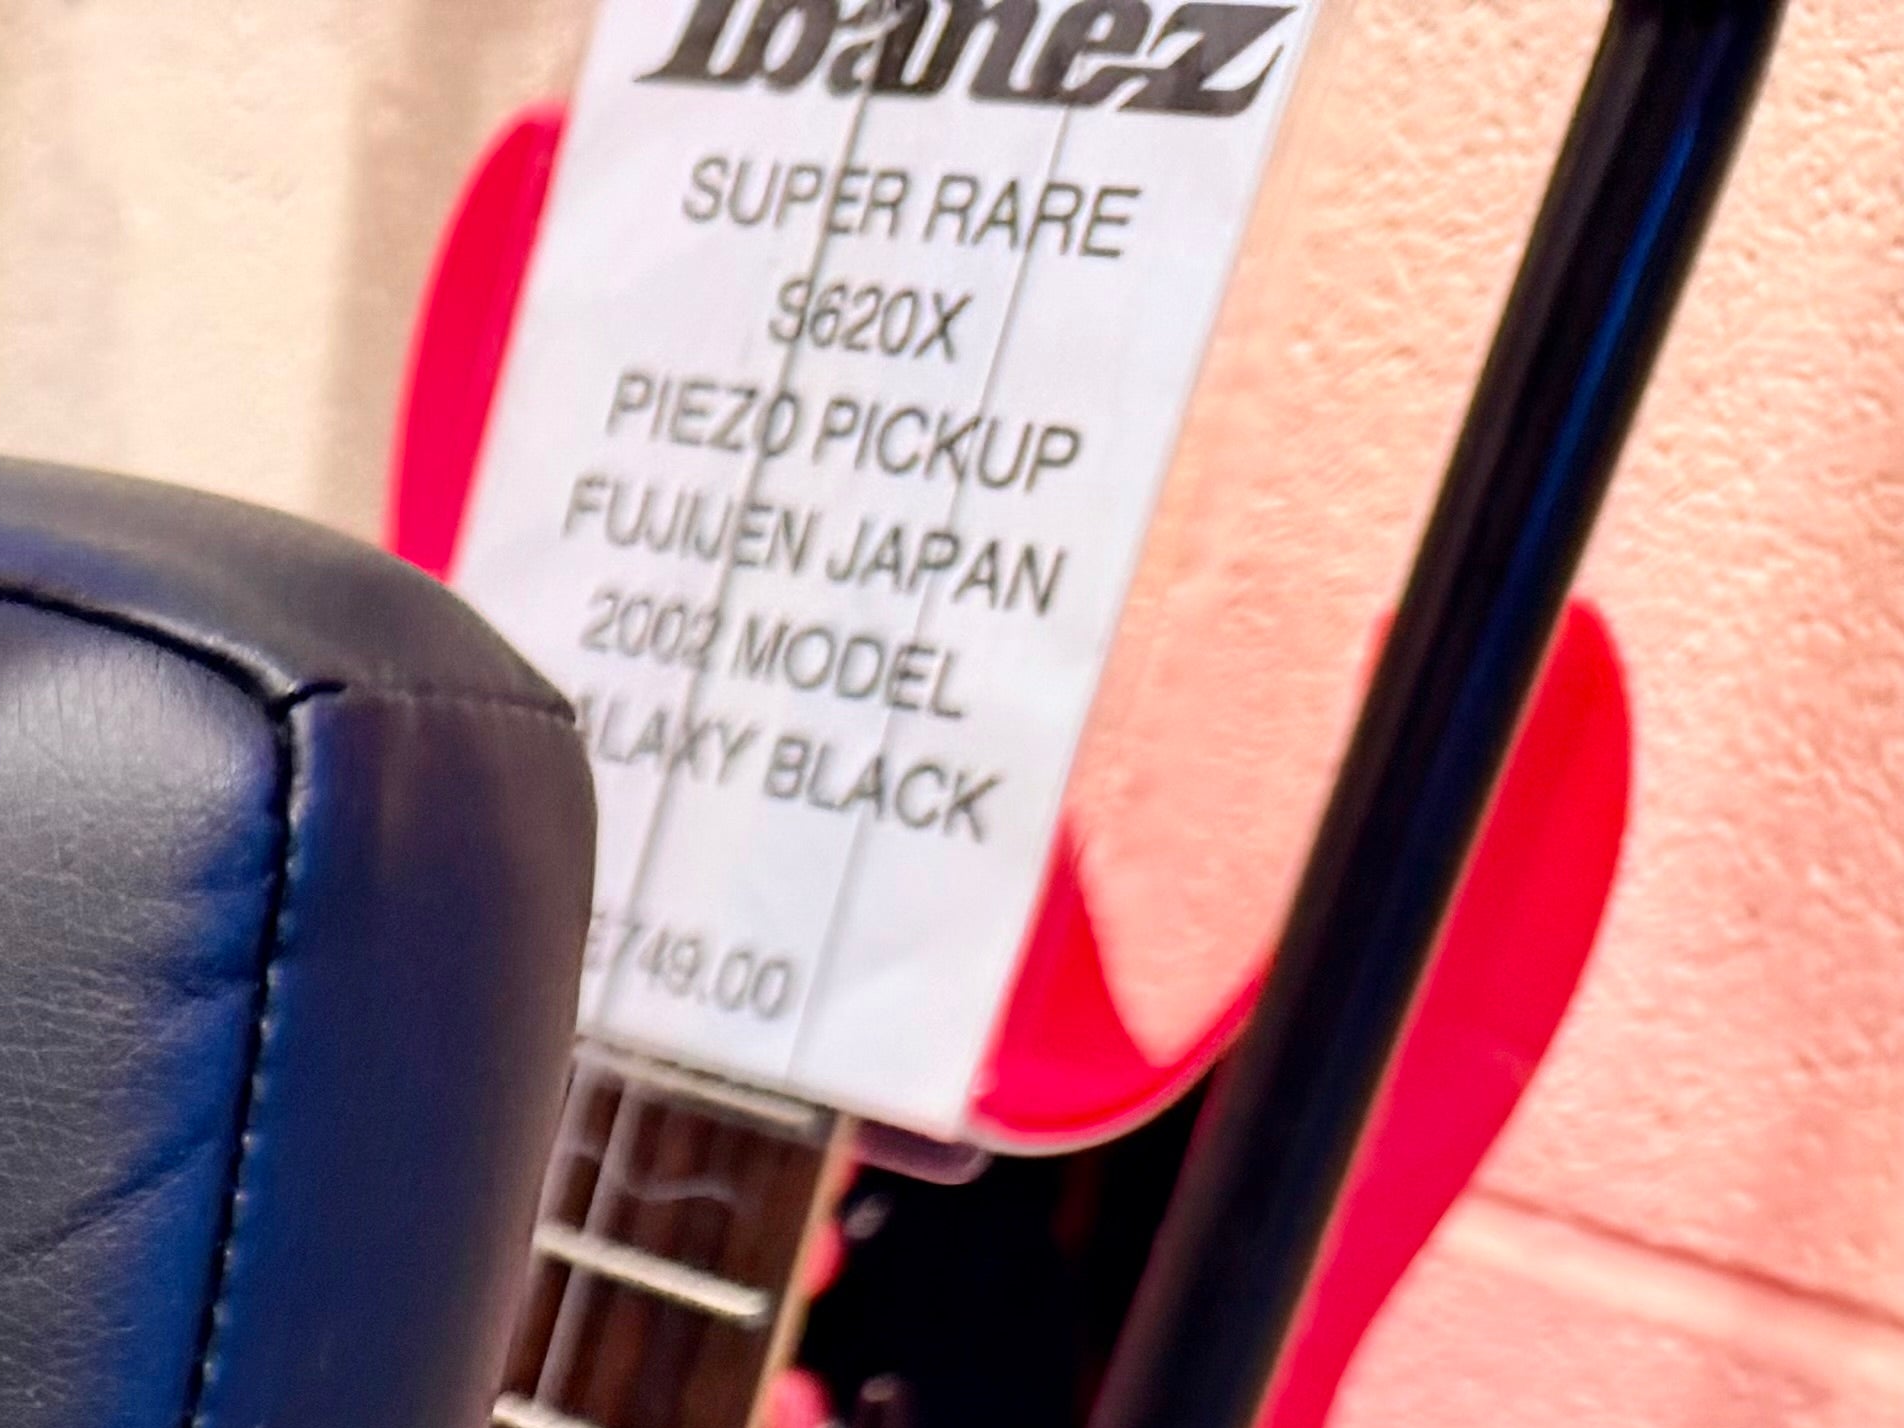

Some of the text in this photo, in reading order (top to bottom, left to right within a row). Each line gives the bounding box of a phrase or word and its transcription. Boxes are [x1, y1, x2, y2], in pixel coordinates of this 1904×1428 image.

[684, 155, 1142, 259] SUPER RARE
[767, 276, 972, 363] S620X
[605, 370, 1082, 494] PIEZO PICKUP
[826, 518, 1067, 616] JAPAN
[732, 612, 964, 719] MODEL
[580, 695, 1003, 844] LAXY BLACK
